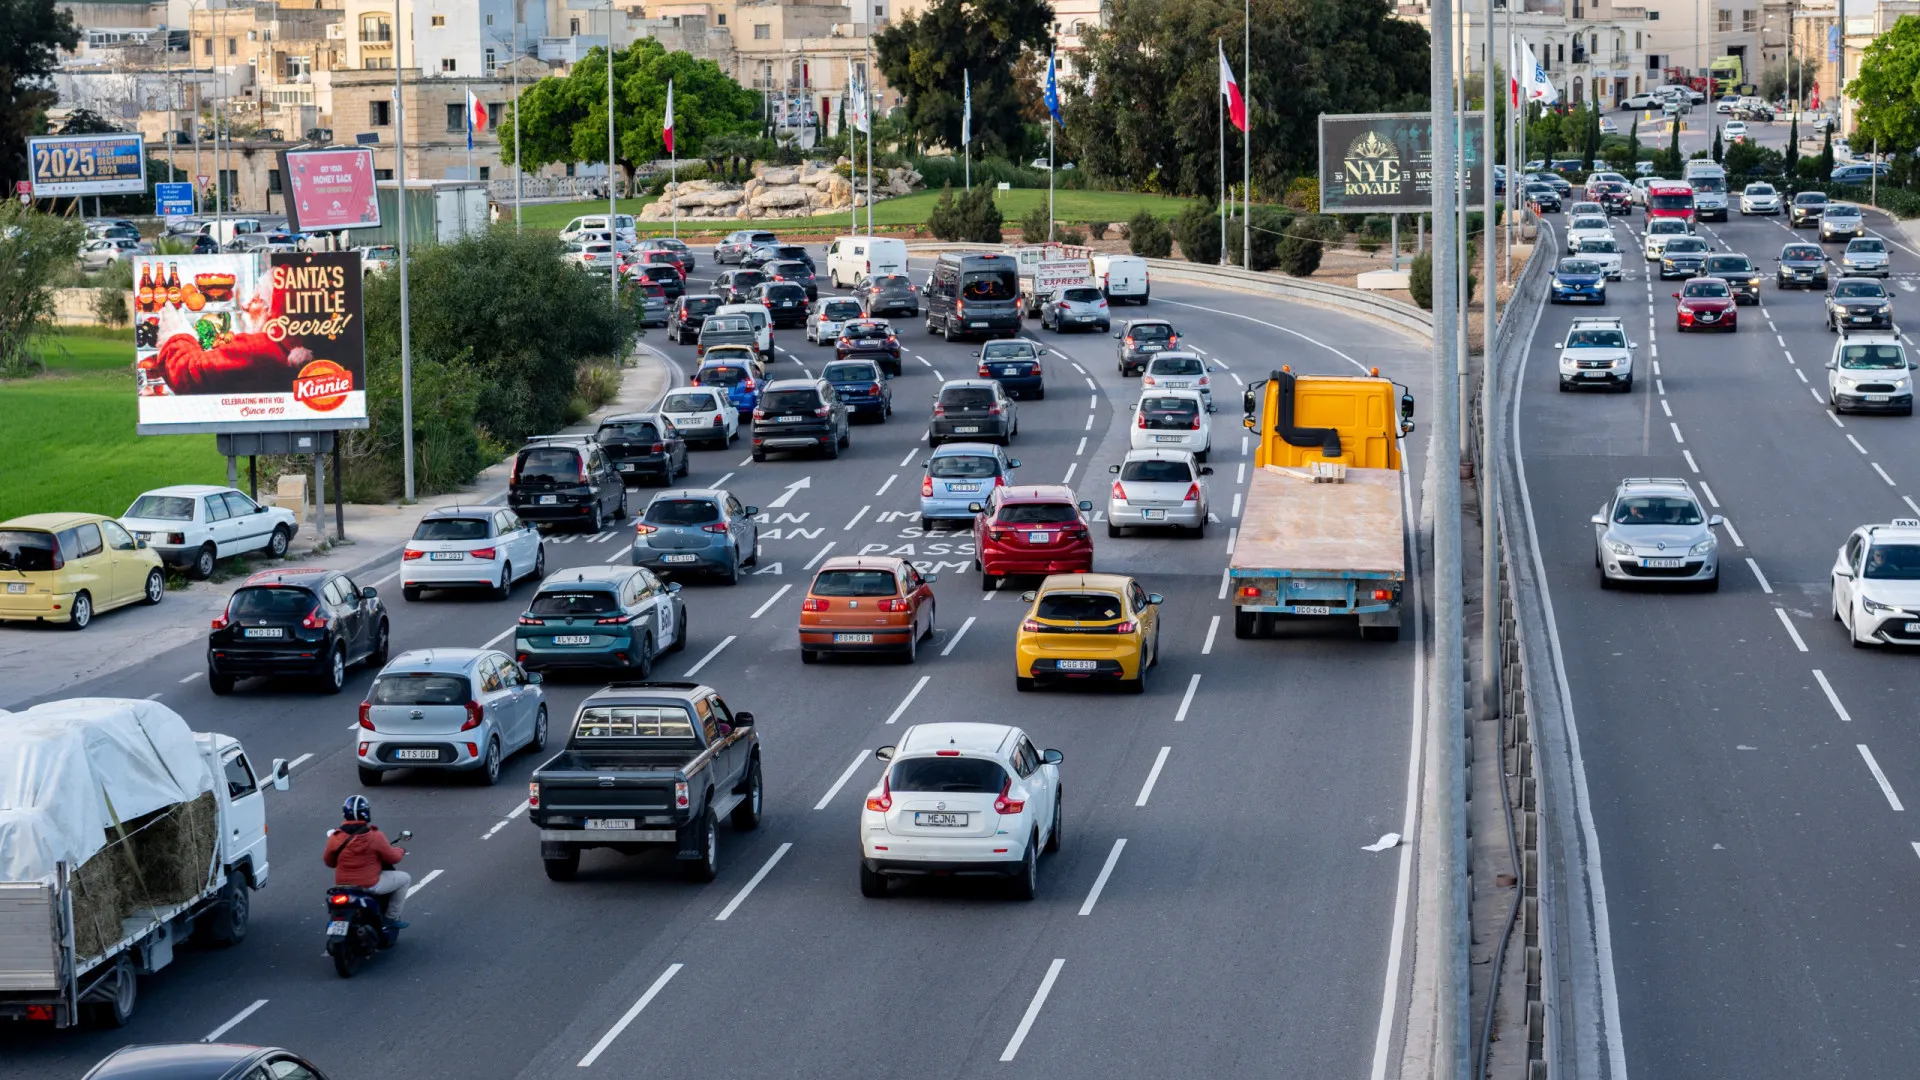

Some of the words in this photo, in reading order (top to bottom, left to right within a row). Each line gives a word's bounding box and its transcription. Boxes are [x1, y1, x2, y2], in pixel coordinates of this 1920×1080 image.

[96, 147, 115, 156] 31ST
[36, 148, 95, 178] 2025
[97, 155, 137, 165] DECEMBER
[98, 165, 118, 175] 2024
[1344, 160, 1400, 182] NYE
[313, 175, 335, 184] MONEY
[336, 174, 352, 184] BACK
[1345, 183, 1401, 195] ROYALE
[273, 266, 344, 289] SANTA'S
[1043, 277, 1086, 286] EXPRESS
[285, 291, 346, 314] LITTLE
[262, 313, 353, 342] Secret!
[297, 378, 349, 399] Kinnie
[221, 398, 258, 406] CELEBRATING
[273, 396, 285, 404] YOU
[240, 406, 266, 417] Since
[268, 406, 285, 415] 1952
[753, 512, 811, 523] AN
[928, 814, 957, 824] MEJNA
